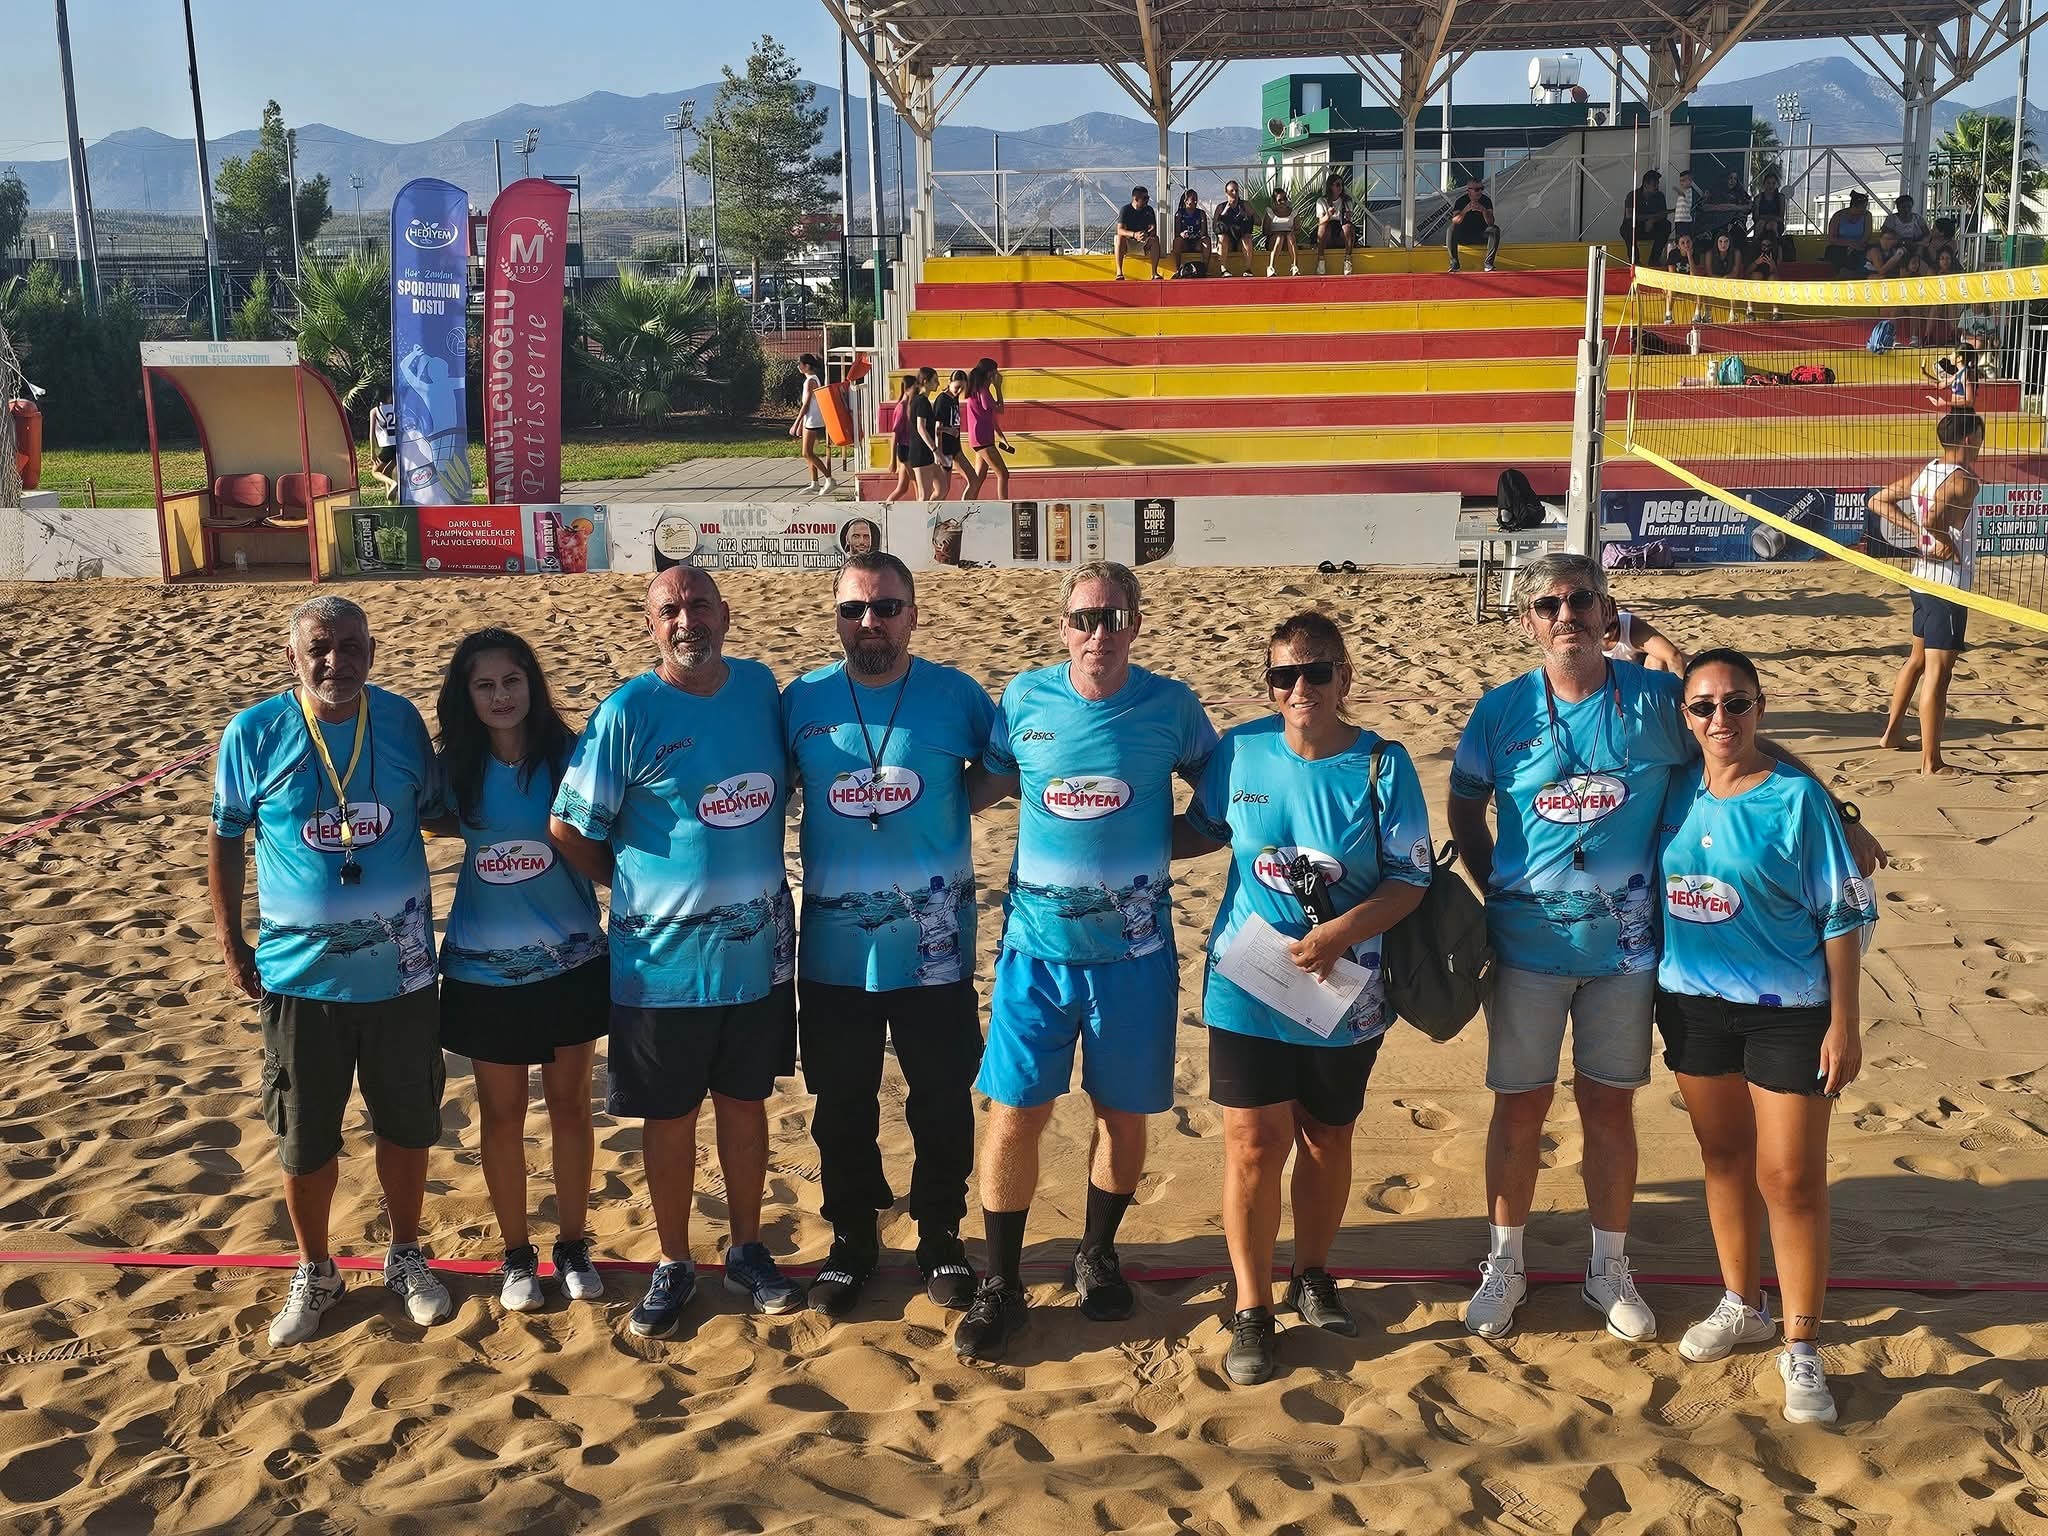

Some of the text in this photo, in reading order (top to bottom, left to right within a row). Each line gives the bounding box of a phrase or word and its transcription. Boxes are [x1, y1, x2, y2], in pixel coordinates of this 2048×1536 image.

[510, 233, 545, 263] M
[514, 265, 539, 274] 1919
[397, 279, 461, 299] SPORCUNUN
[412, 298, 446, 316] DOSTU
[516, 314, 548, 495] Patisserie
[1834, 493, 1866, 507] DARK
[2008, 489, 2043, 502] KKTC
[1143, 509, 1166, 519] DARK
[1639, 500, 1684, 536] pes
[1834, 507, 1865, 520] BLUE
[448, 520, 492, 528] DARK BLUE
[1144, 520, 1165, 530] CAFE
[1647, 524, 1746, 537] DarkBlue Energy Drink
[475, 529, 516, 537] MELEKLER
[717, 538, 737, 552] 2023
[784, 538, 820, 552] MELEKLER
[692, 554, 719, 568] OSMAN
[1032, 731, 1056, 741] asics
[666, 737, 693, 754] asics
[1518, 737, 1543, 751] asics
[1243, 793, 1270, 804] asics
[307, 821, 383, 840] HEDYEM
